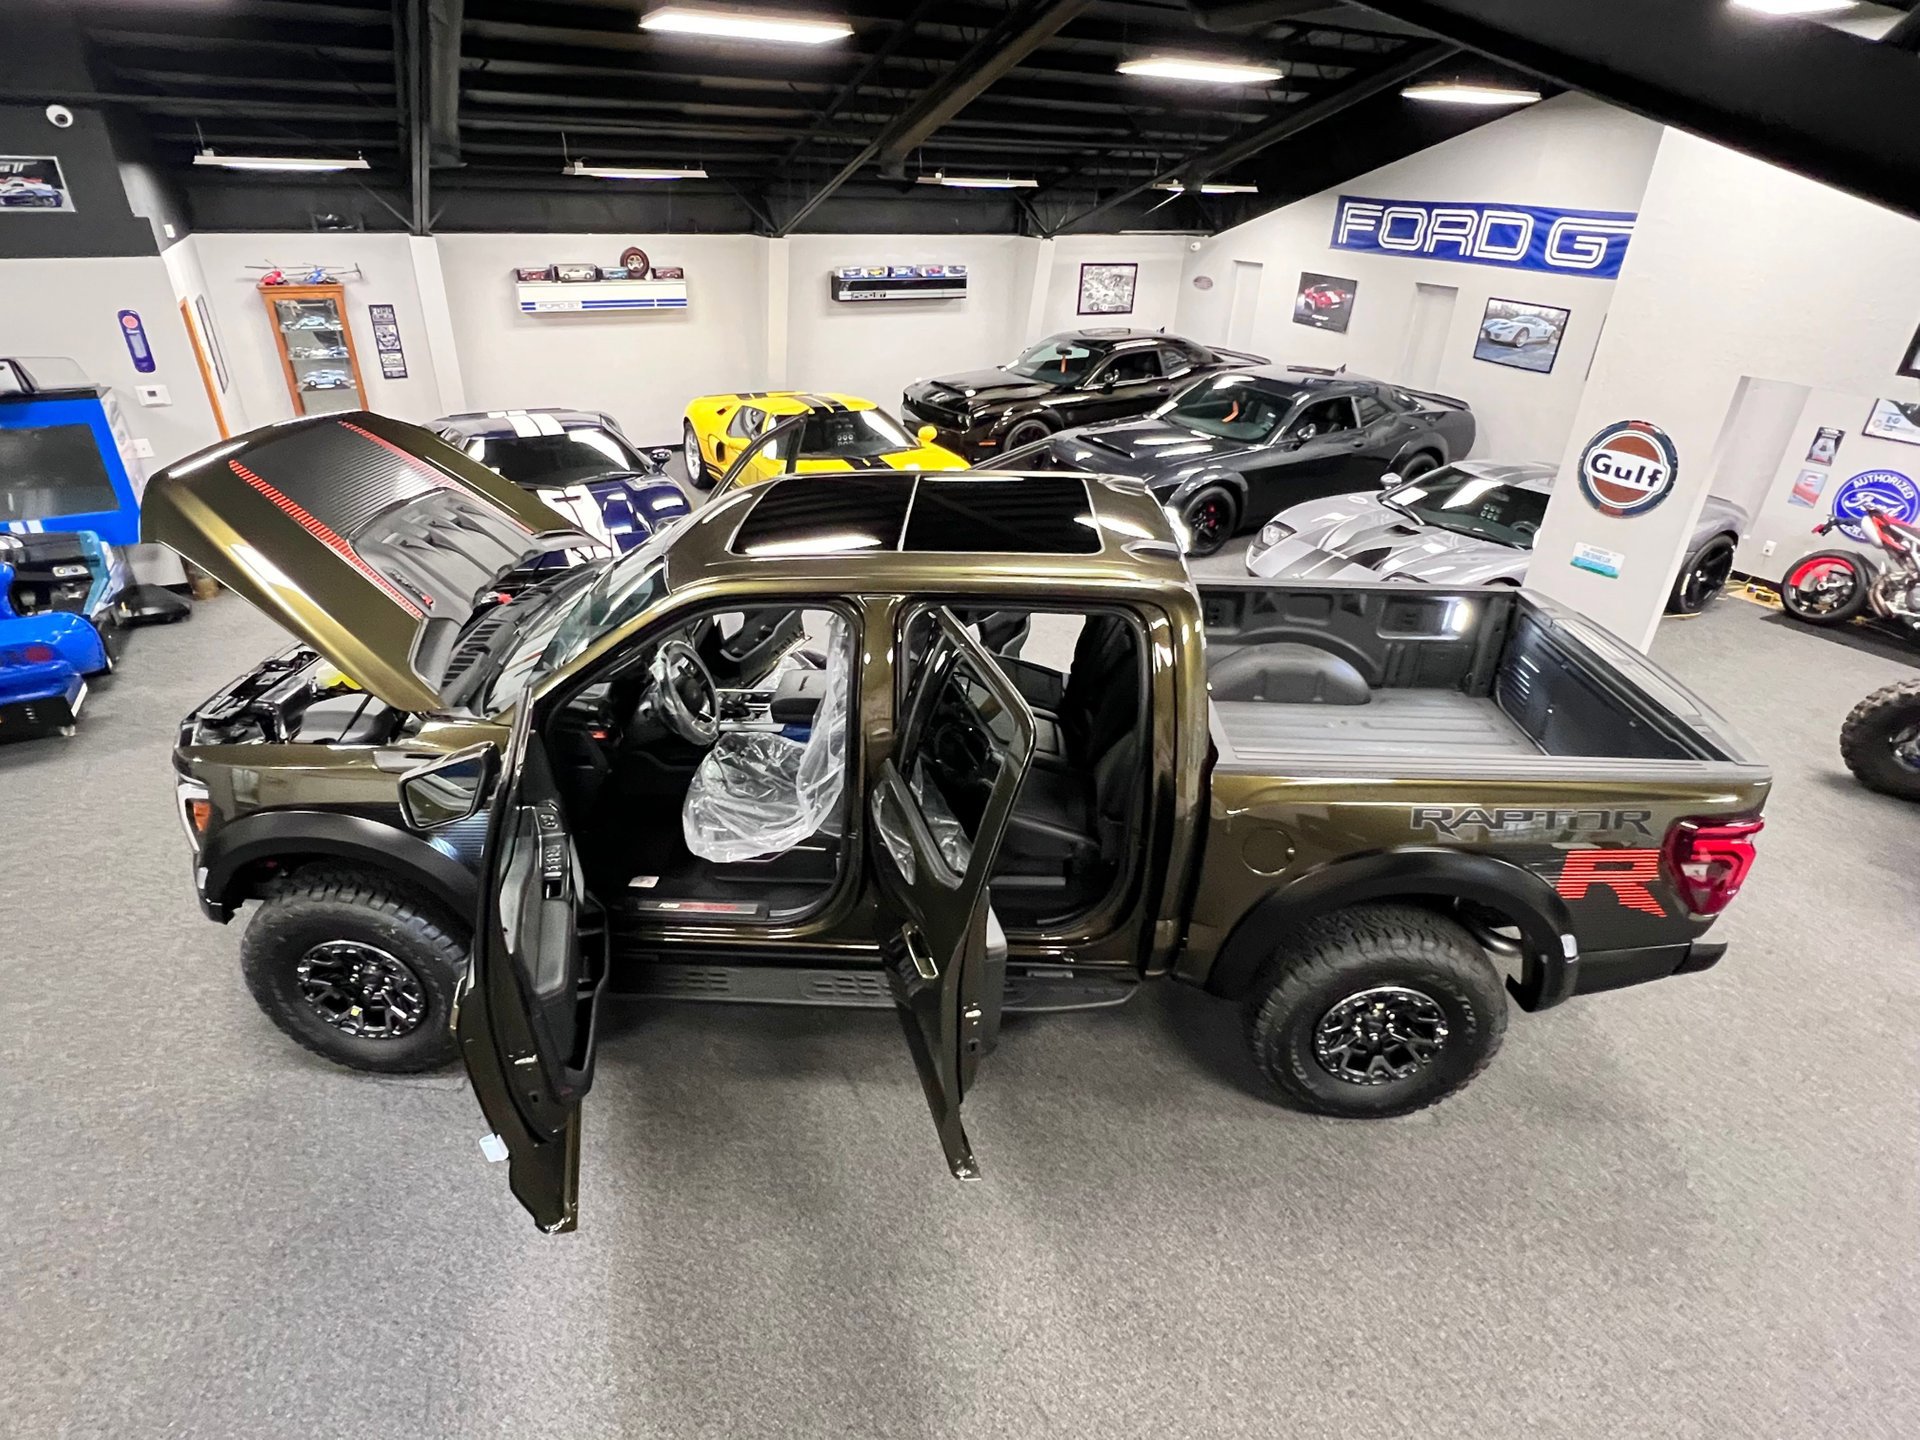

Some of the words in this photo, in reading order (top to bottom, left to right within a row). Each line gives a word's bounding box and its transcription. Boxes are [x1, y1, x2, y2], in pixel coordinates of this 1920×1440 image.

[1338, 202, 1534, 261] FORD
[1545, 216, 1637, 269] G
[1591, 453, 1663, 487] Gulf
[1853, 474, 1915, 499] AUTHORIZED
[1844, 491, 1905, 517] Ford
[1410, 806, 1656, 840] RAPTOR
[1555, 847, 1668, 918] R
